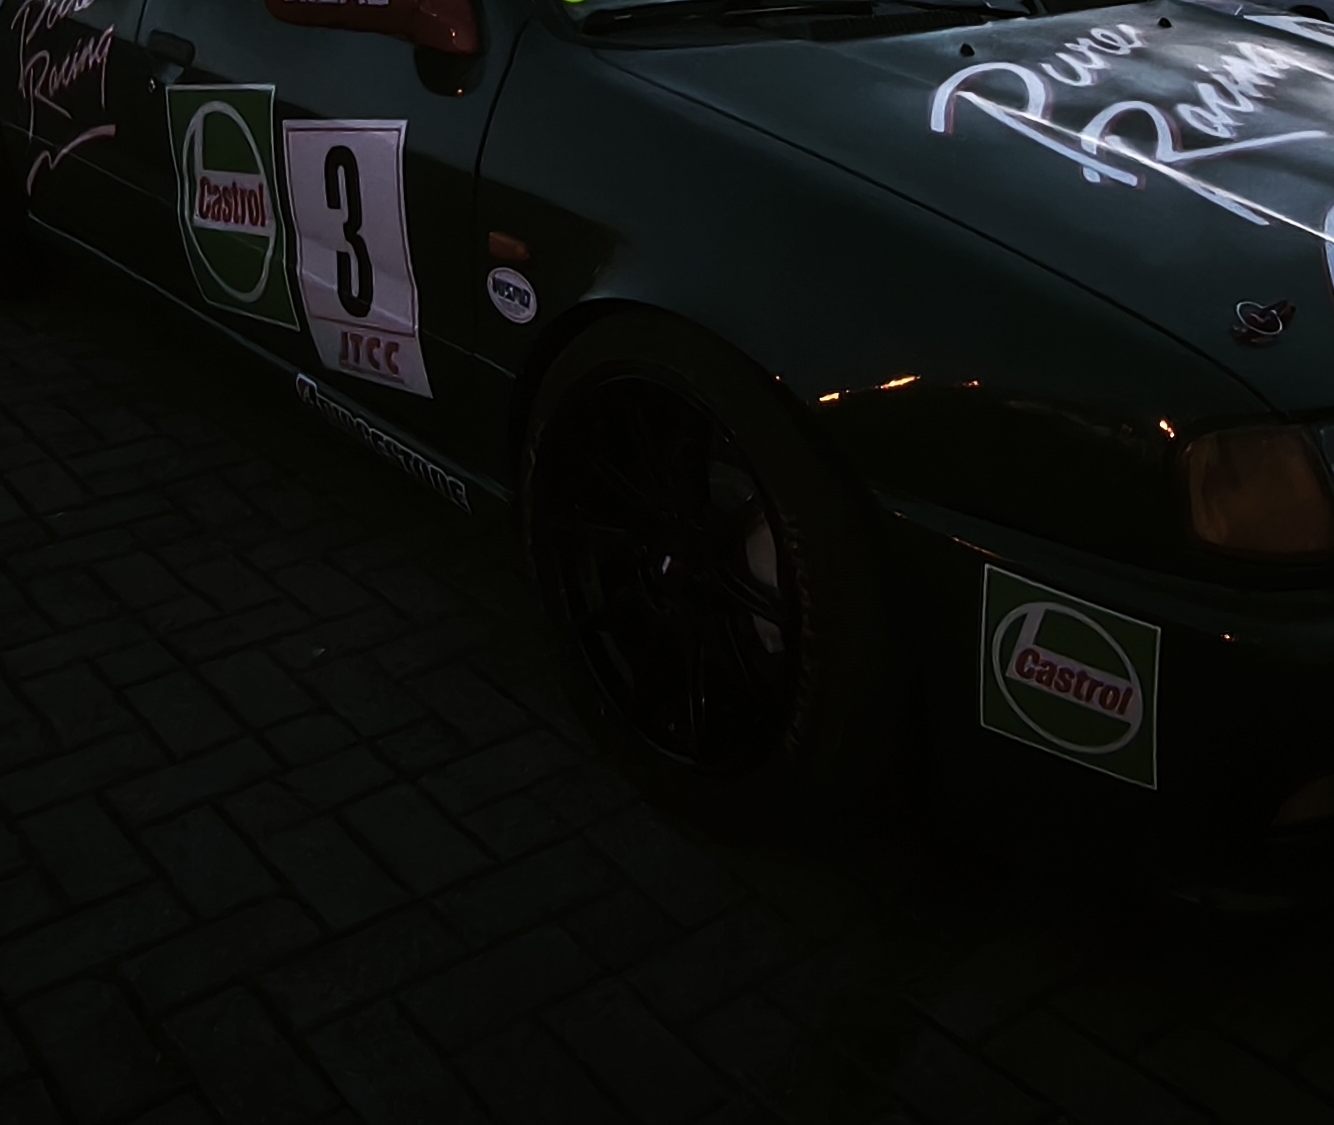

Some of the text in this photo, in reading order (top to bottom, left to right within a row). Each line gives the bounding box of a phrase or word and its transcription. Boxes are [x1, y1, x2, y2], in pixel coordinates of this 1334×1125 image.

[198, 176, 267, 227] Castrol
[324, 145, 374, 318] 3
[1015, 648, 1133, 716] Castrol
